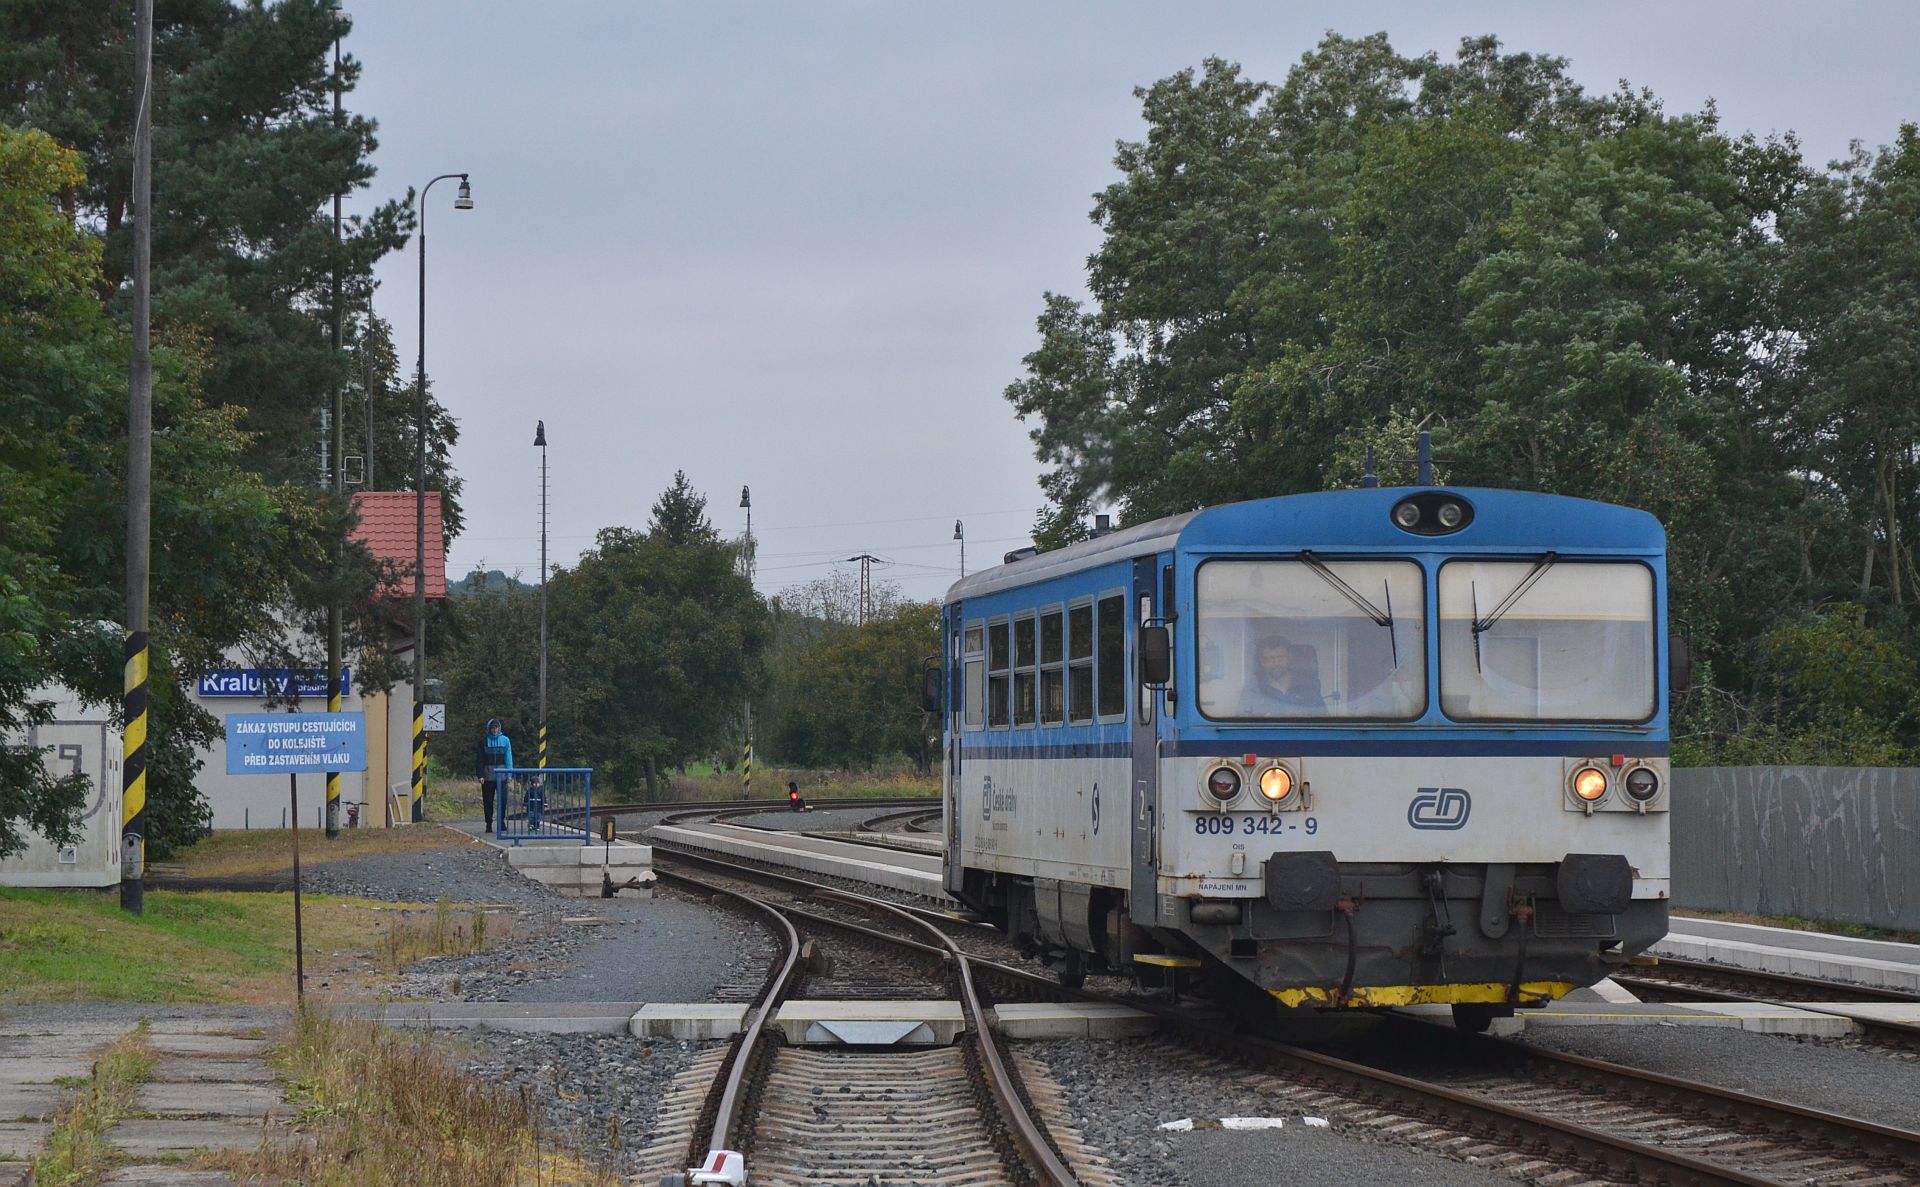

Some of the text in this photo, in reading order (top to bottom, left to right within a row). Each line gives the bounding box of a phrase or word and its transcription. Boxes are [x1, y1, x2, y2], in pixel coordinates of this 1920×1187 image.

[236, 718, 356, 734] ZÁKAZ VSTUPU CESTUJÍCÍCH
[268, 736, 327, 749] DO KOLEJIŠTĚ
[244, 752, 350, 766] PŘED ZASTAVENÍM VLAKU
[1139, 789, 1145, 821] 2
[1195, 816, 1234, 835] 809
[1243, 816, 1282, 835] 342
[1305, 816, 1318, 835] 9
[1198, 883, 1234, 891] NAPÁJENÍ
